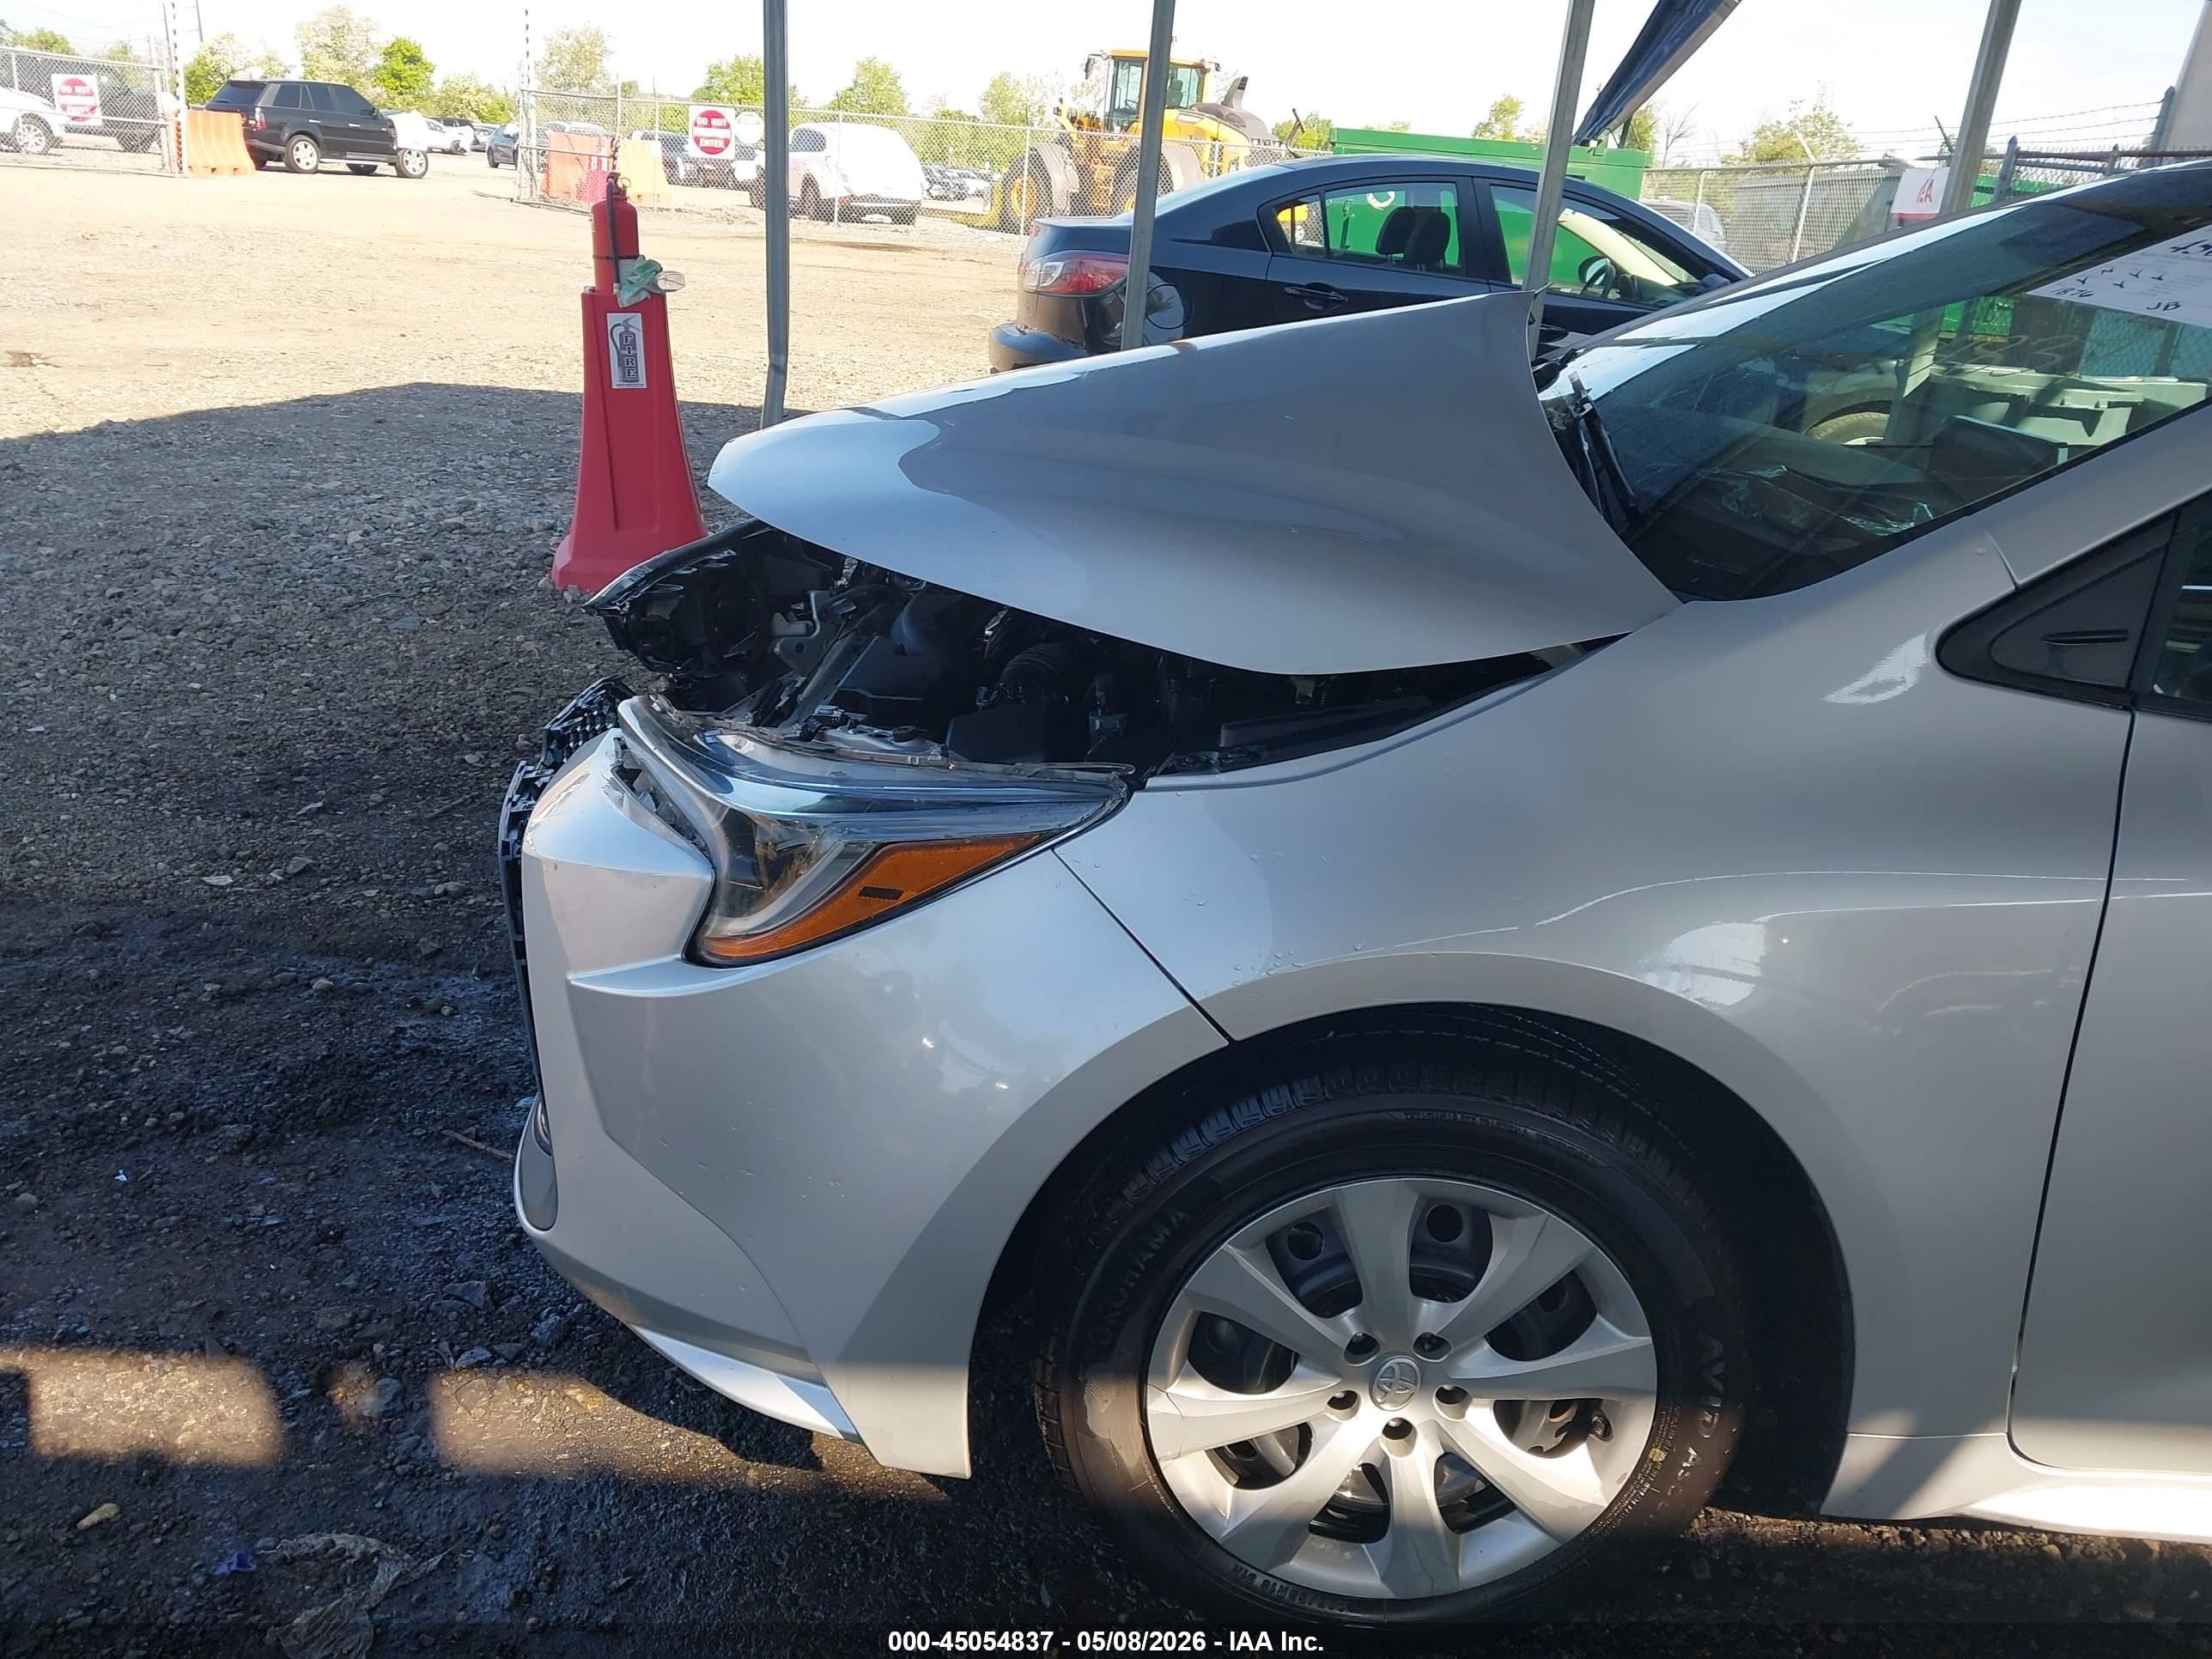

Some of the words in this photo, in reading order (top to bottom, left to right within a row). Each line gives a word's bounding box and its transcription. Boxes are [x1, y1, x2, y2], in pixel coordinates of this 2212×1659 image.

[696, 116, 708, 126] DO
[711, 117, 728, 127] NOT
[623, 334, 637, 378] FIRE
